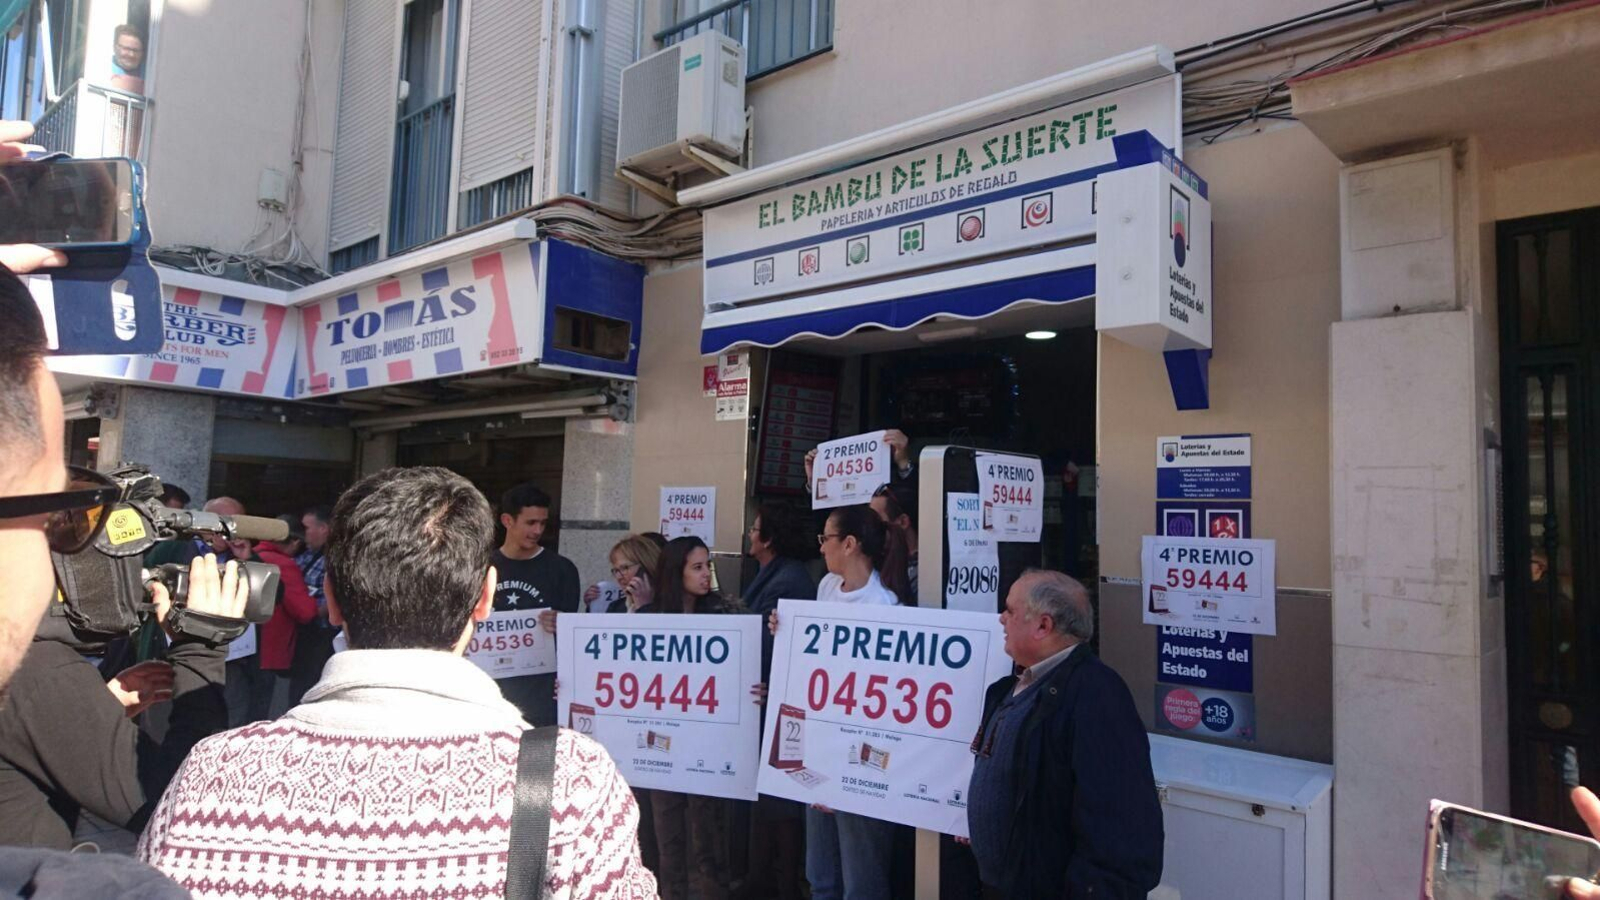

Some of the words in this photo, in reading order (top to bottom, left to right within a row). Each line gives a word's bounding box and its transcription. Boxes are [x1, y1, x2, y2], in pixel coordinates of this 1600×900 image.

[758, 200, 786, 229] EL
[791, 170, 883, 222] BAMBU
[890, 158, 927, 196] DE
[936, 147, 973, 183] LA
[980, 104, 1118, 171] SUERTE
[820, 209, 875, 231] PAPELERIA
[875, 204, 884, 217] Y
[884, 188, 947, 216] ARTICULOS
[949, 184, 965, 199] DE
[967, 170, 1018, 195] REGALO
[1170, 284, 1195, 310] Apuestas
[1195, 298, 1205, 314] del
[163, 302, 198, 316] THE
[1169, 302, 1189, 324] Estado
[165, 330, 206, 345] LUB
[383, 335, 415, 357] HOMBRES
[180, 345, 201, 355] FOR
[204, 348, 230, 359] MEN
[180, 355, 201, 365] 1965
[719, 381, 747, 393] Alarma
[834, 440, 878, 459] PREMIO
[1181, 450, 1210, 458] Apuestas
[826, 456, 874, 478] 04536
[997, 463, 1035, 483] PREMIO
[674, 494, 708, 505] PREMIO
[992, 484, 1033, 506] 59444
[669, 507, 705, 521] 59444
[1178, 548, 1254, 567] PREMIO
[496, 580, 540, 598] REMIUM
[948, 565, 998, 595] 92086
[1166, 568, 1248, 592] 59444
[477, 617, 537, 633] PREMIO
[468, 632, 535, 653] 04536
[612, 633, 730, 665] PREMIO
[831, 624, 973, 669] PREMIO
[1162, 642, 1223, 660] Apuestas
[1226, 648, 1249, 663] del
[1162, 661, 1208, 678] Estado
[594, 671, 719, 714] 59444
[807, 668, 953, 729] 04536
[1167, 696, 1199, 708] Primera
[1165, 705, 1186, 714] regla
[1205, 704, 1229, 718] +18
[579, 716, 593, 735] 22
[1206, 714, 1227, 725] años
[785, 720, 802, 743] 22
[849, 777, 857, 785] DE
[858, 779, 890, 791] DICIEMBRE
